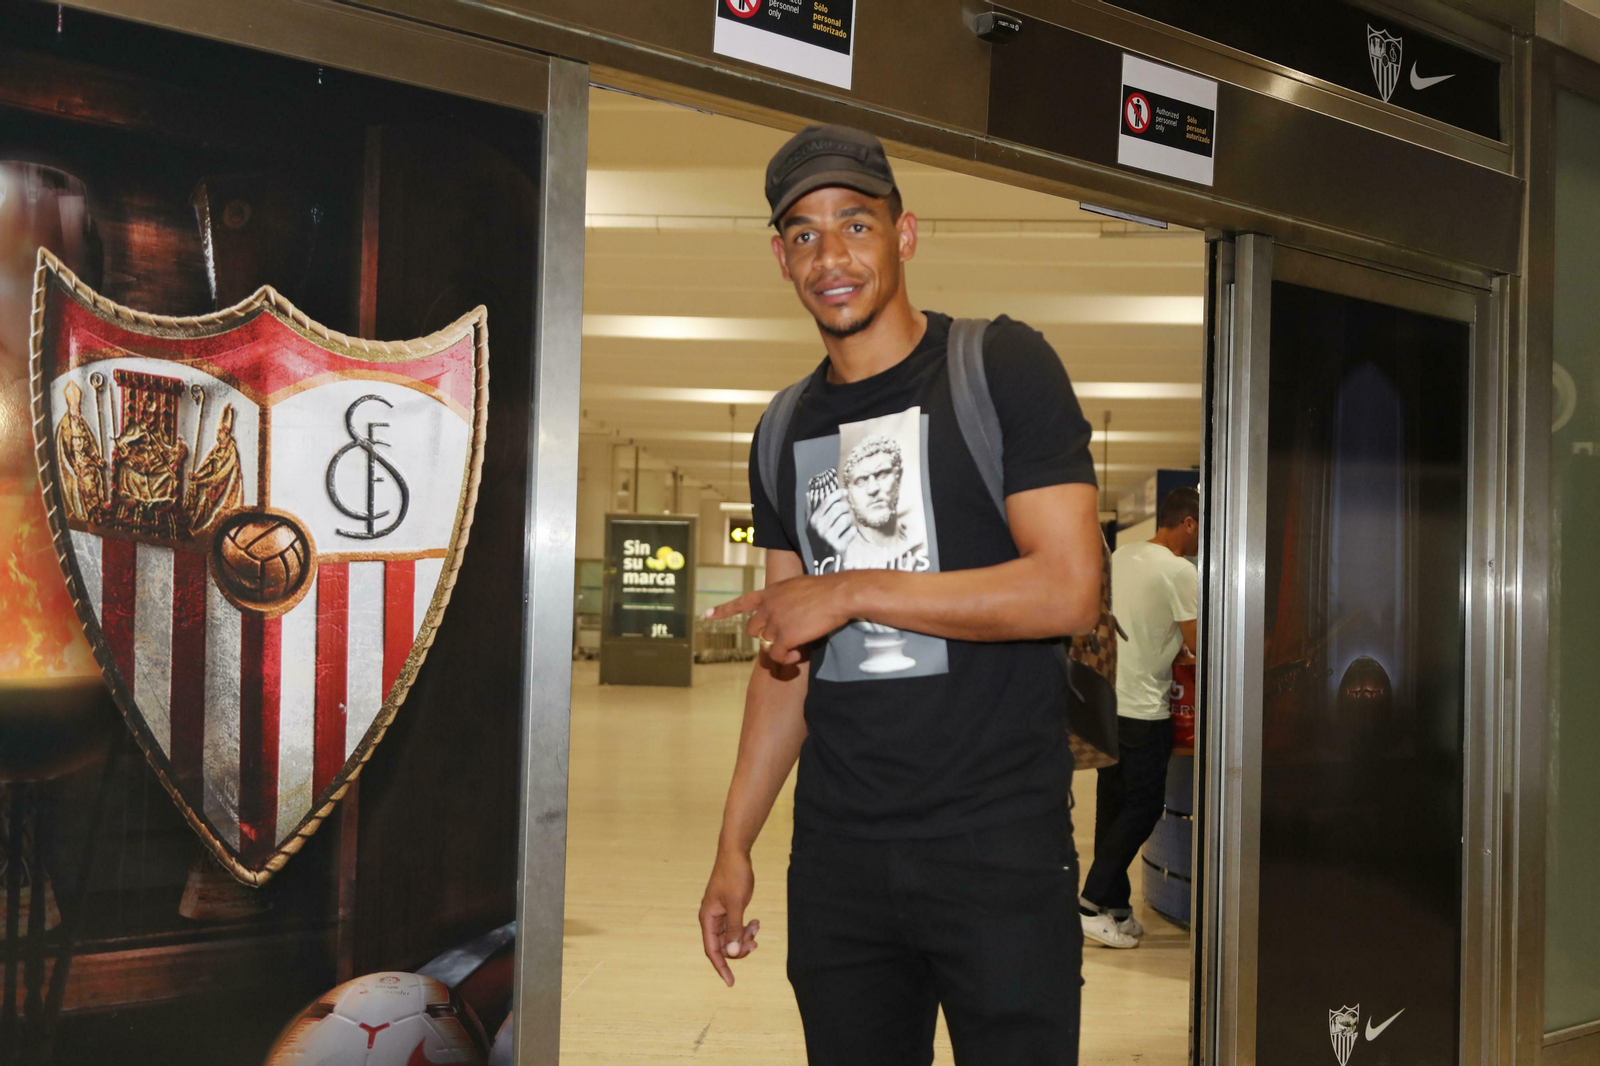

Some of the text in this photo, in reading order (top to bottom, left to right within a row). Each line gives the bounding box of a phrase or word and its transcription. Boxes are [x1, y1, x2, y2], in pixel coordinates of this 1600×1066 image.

[813, 1, 829, 13] Sólo
[768, 8, 782, 20] only
[812, 12, 842, 27] personal
[812, 22, 847, 39] autorizado
[1156, 107, 1179, 119] Authorized
[1155, 116, 1177, 126] personnel
[1155, 123, 1165, 133] only
[1186, 125, 1206, 135] personal
[1186, 133, 1210, 144] autorizado
[623, 539, 651, 556] Sin
[622, 557, 644, 571] su
[622, 571, 676, 586] marca
